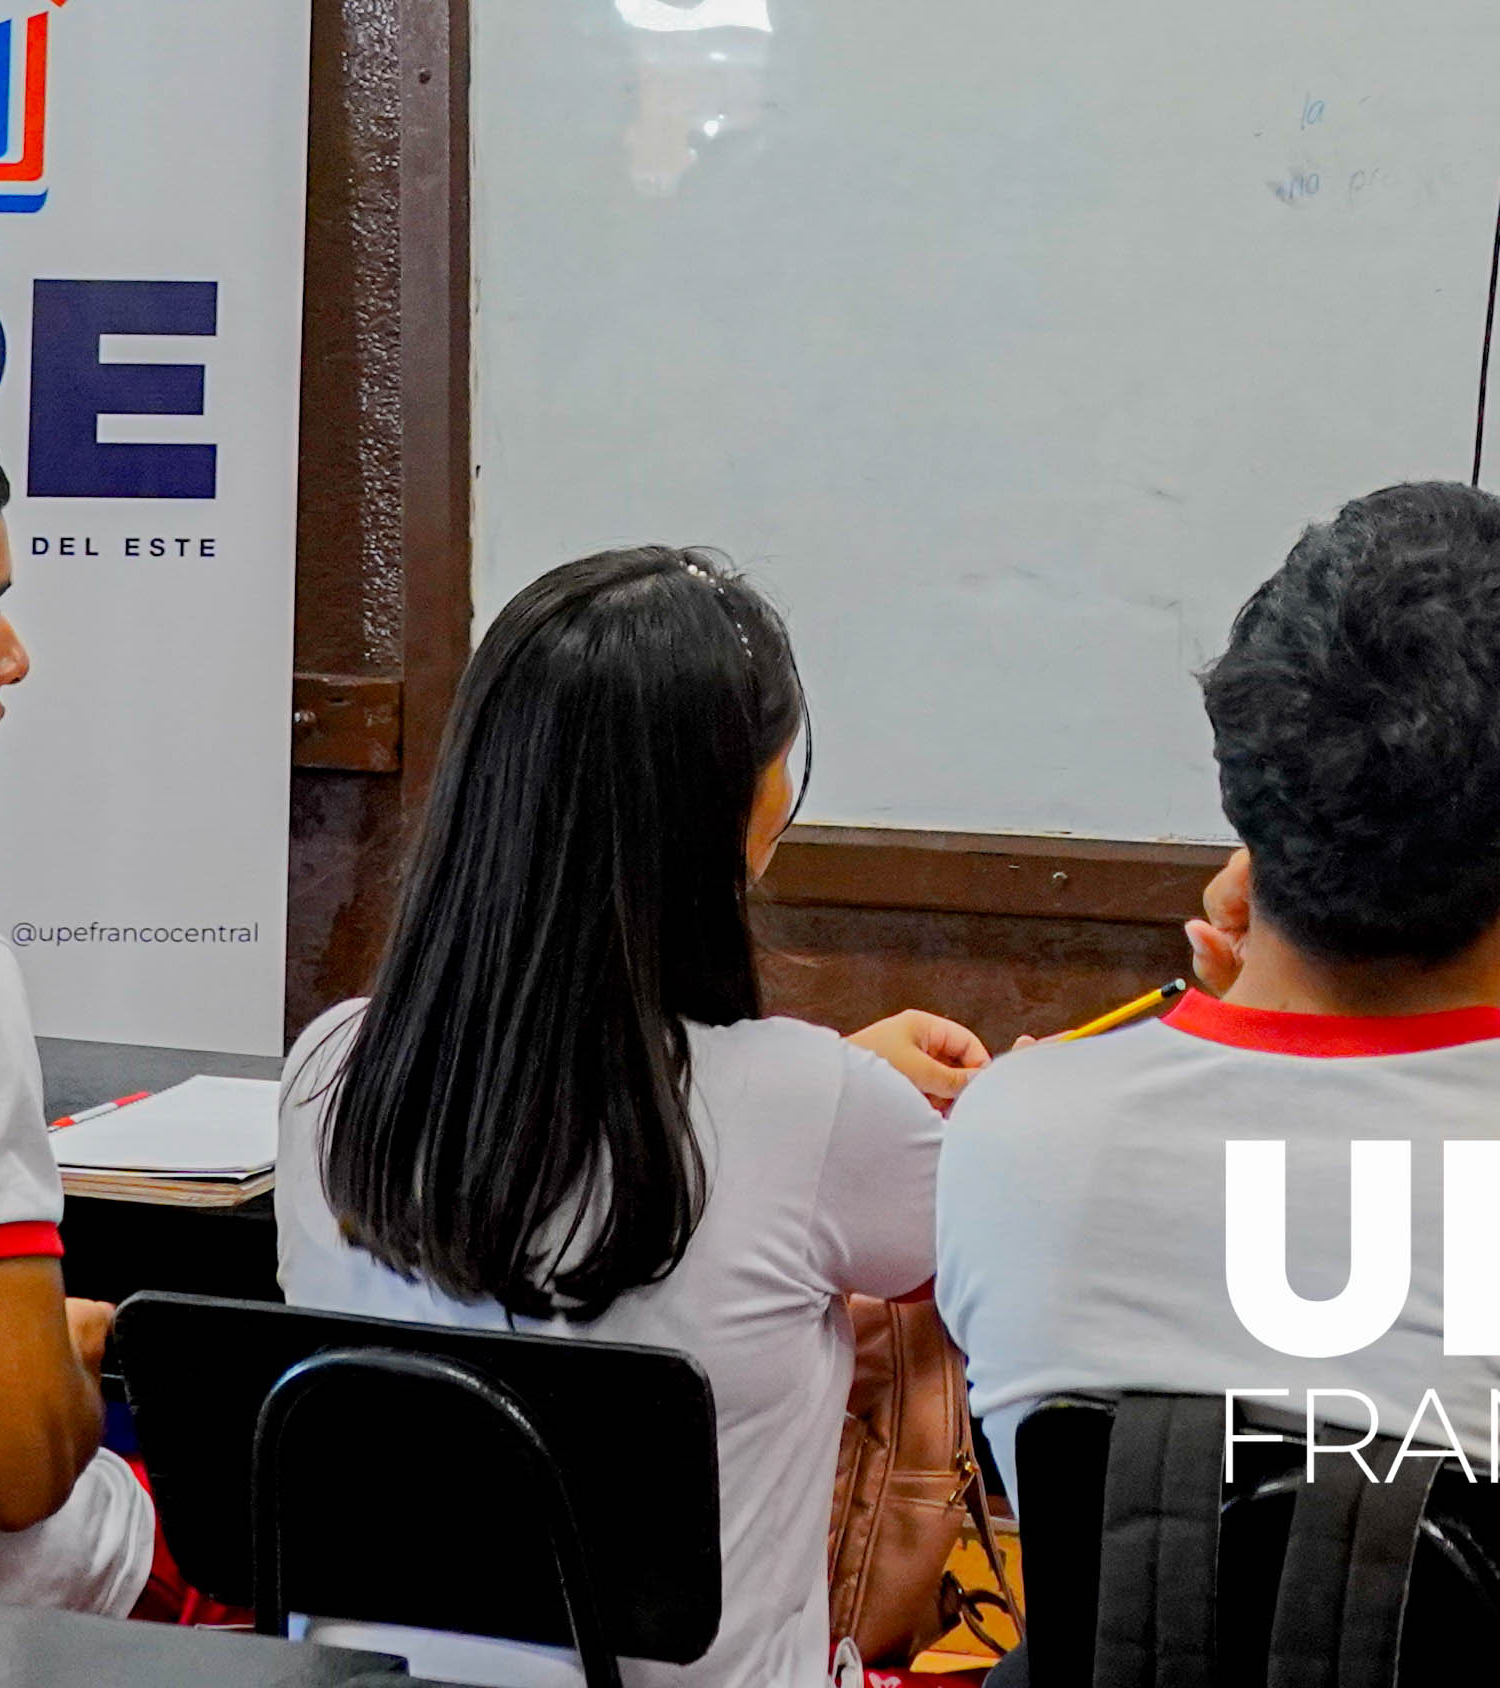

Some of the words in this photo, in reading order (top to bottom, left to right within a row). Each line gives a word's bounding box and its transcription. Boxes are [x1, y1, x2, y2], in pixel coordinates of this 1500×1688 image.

[32, 536, 99, 556] DEL
[124, 537, 217, 558] ESTE
[11, 922, 259, 946] @upefrancocentral
